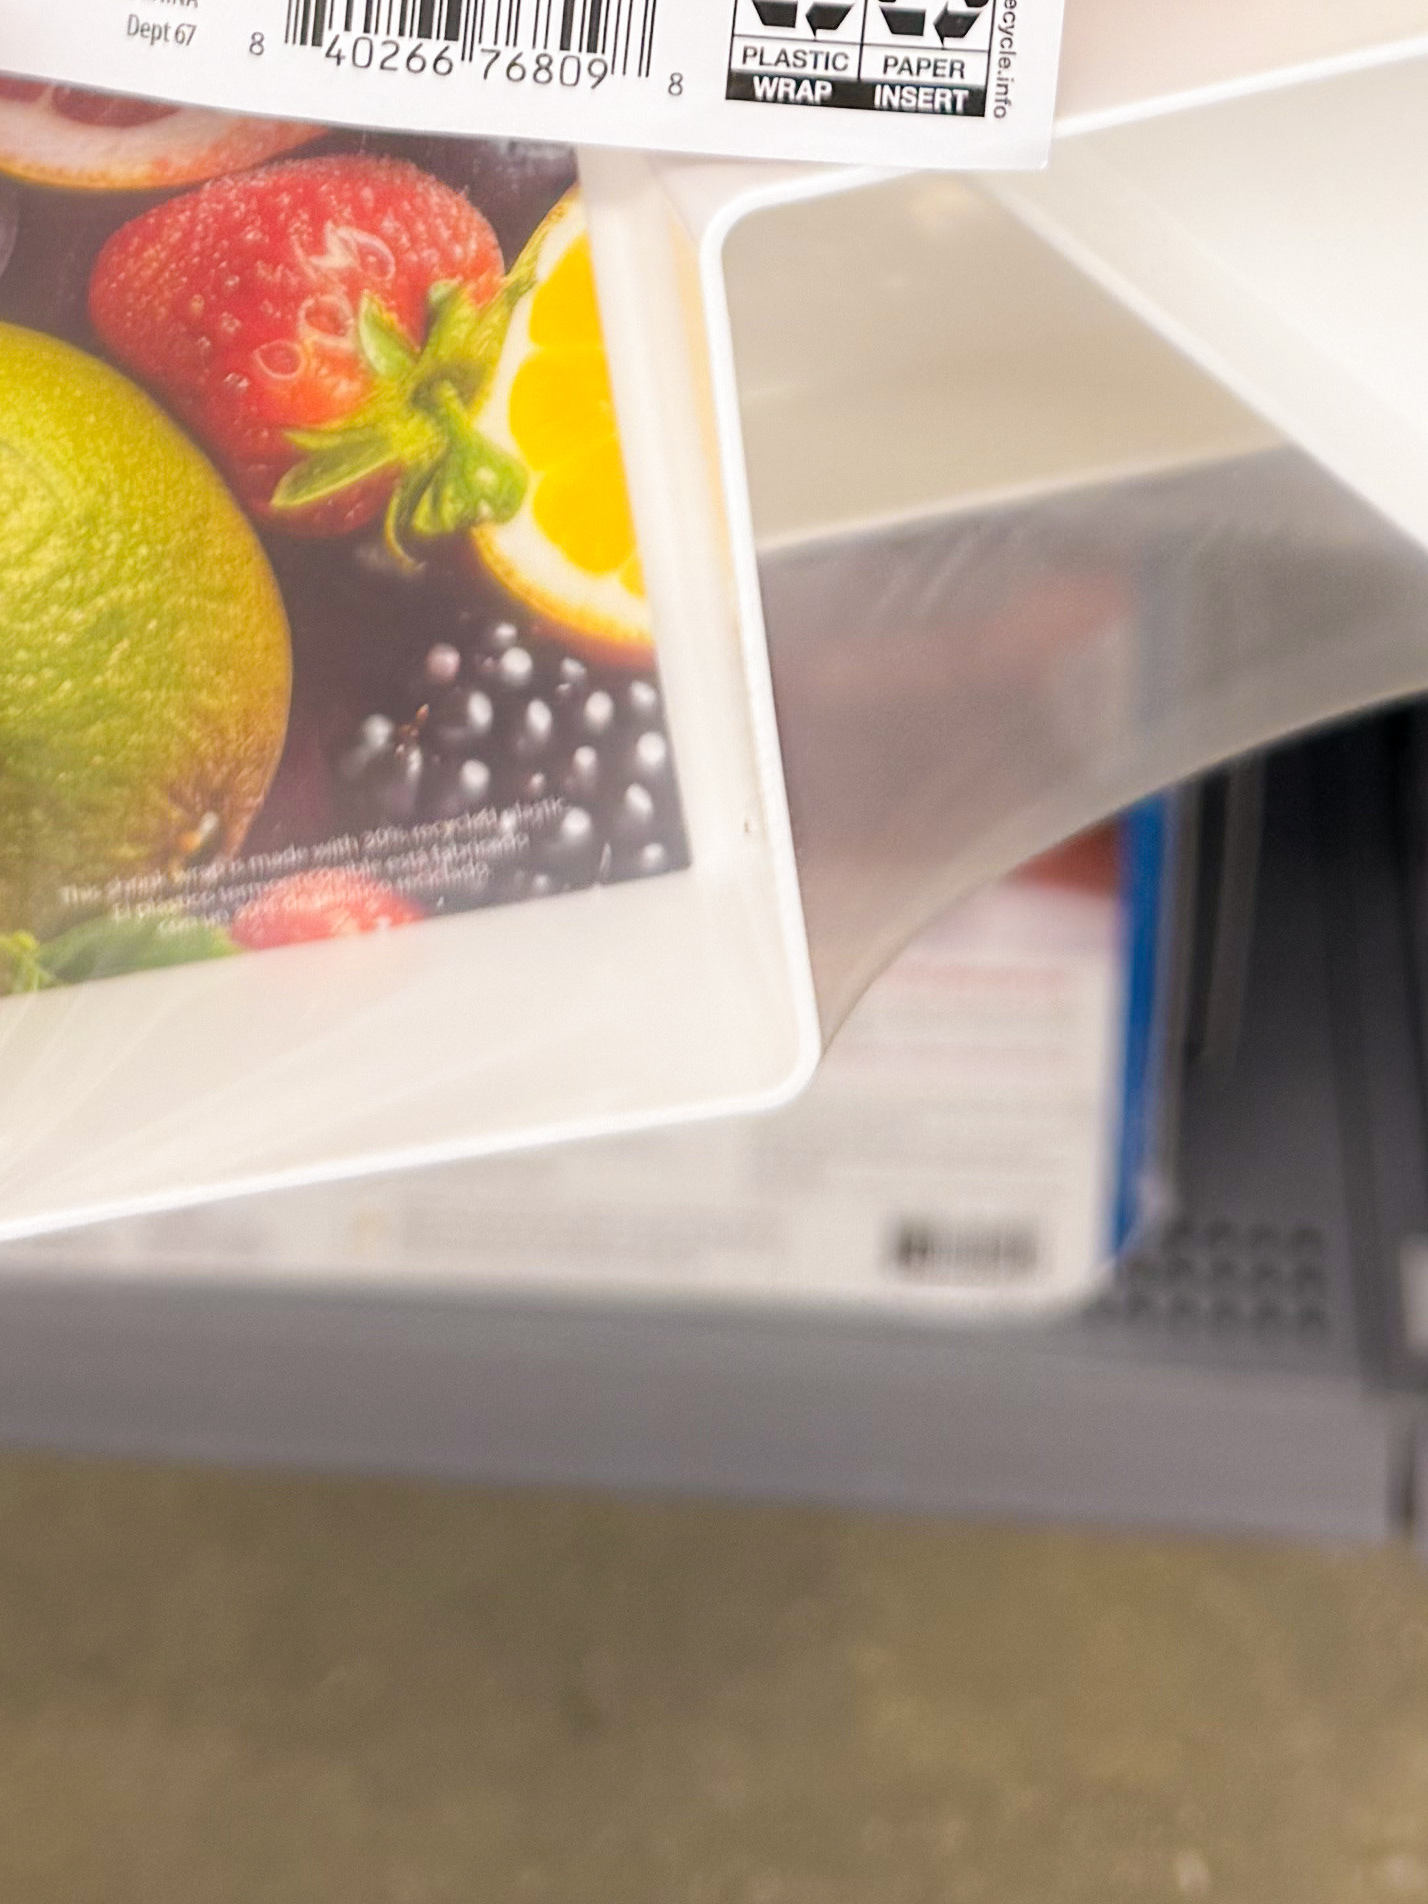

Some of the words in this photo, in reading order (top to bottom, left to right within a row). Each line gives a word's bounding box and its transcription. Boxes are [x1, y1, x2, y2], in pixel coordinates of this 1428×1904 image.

[127, 13, 171, 45] Dept
[174, 23, 197, 46] 67
[248, 31, 266, 57] 8
[324, 33, 455, 78] 40266
[480, 48, 610, 91] 76809
[668, 72, 685, 97] 8
[741, 45, 850, 73] PLASTIC
[882, 54, 966, 80] PAPER
[753, 74, 833, 105] WRAP
[874, 84, 969, 114] INSERT
